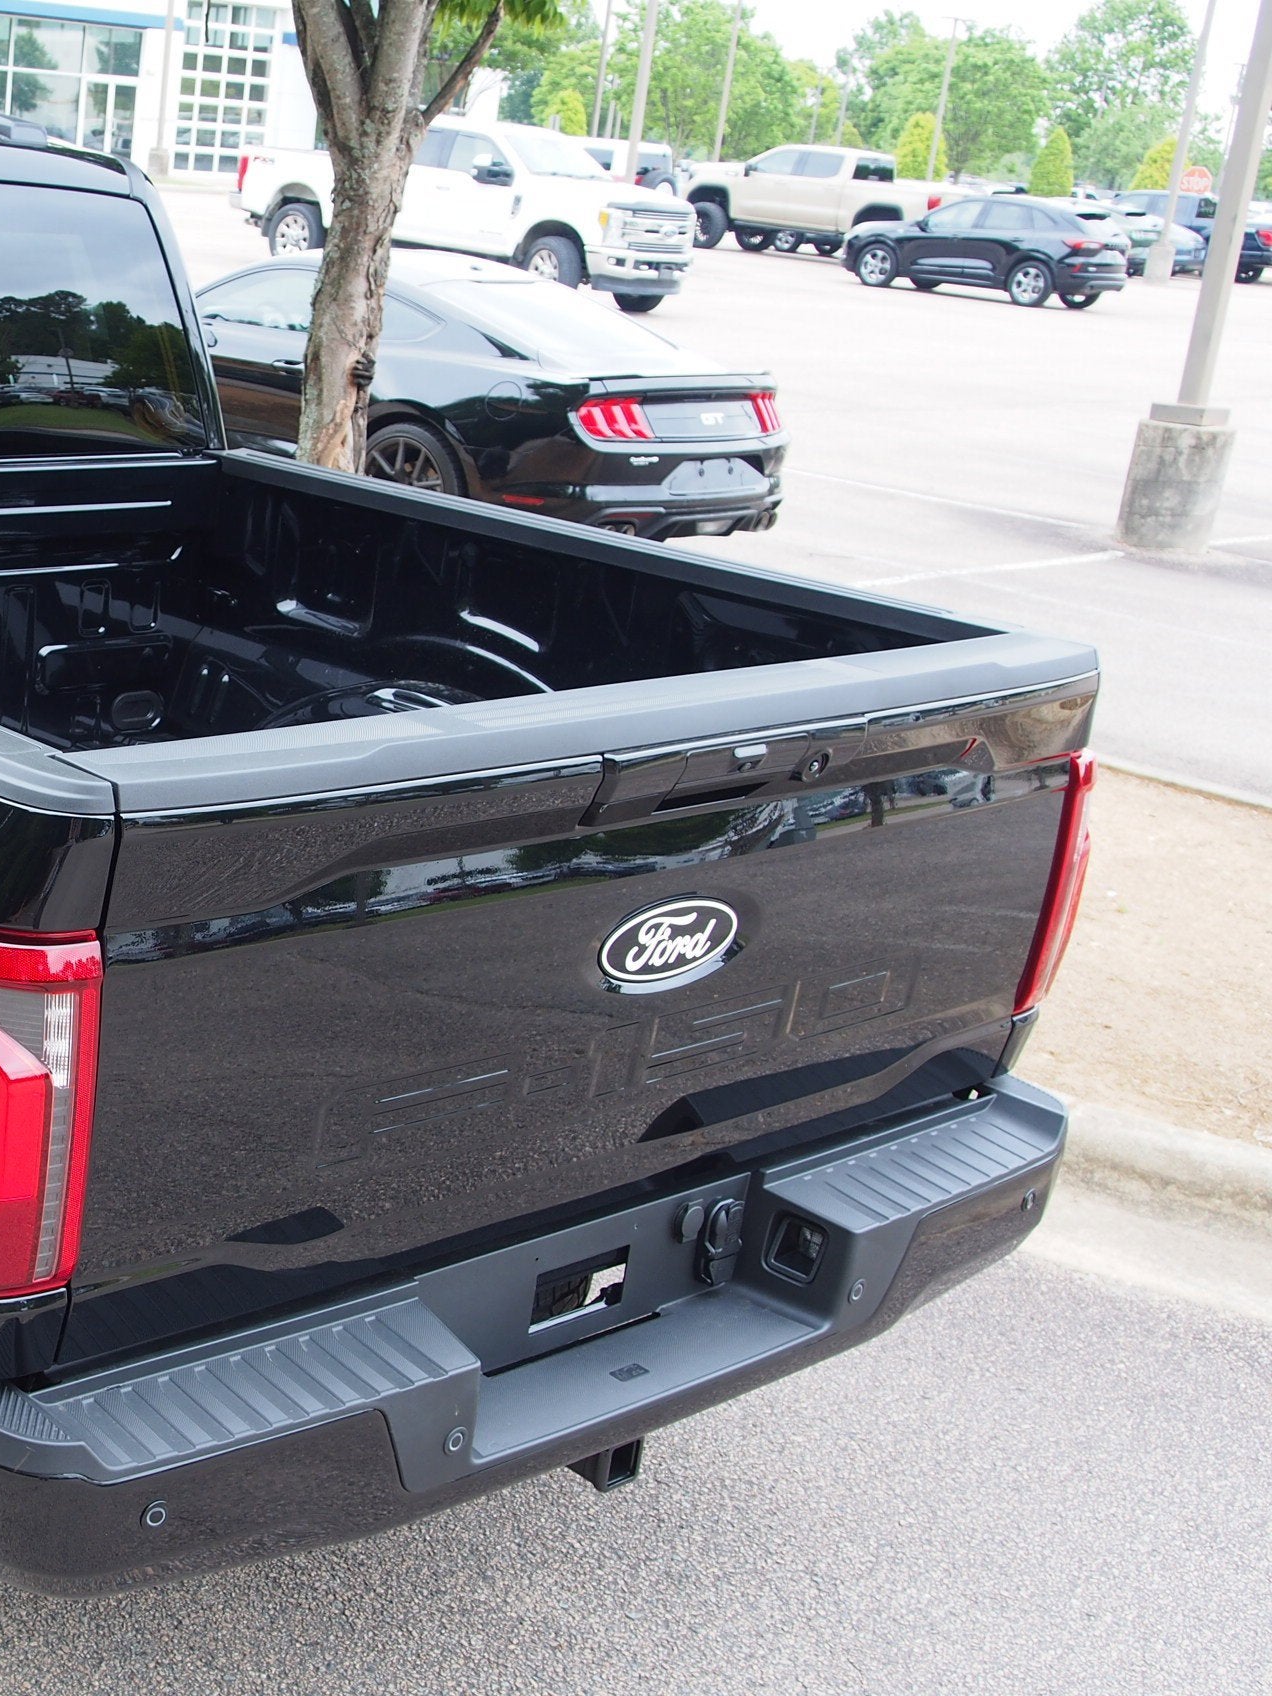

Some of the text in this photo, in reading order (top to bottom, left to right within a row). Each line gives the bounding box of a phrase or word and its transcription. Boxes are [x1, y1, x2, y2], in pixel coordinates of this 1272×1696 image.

[1182, 176, 1209, 191] STOP
[700, 412, 725, 426] GT
[624, 911, 717, 972] Ford
